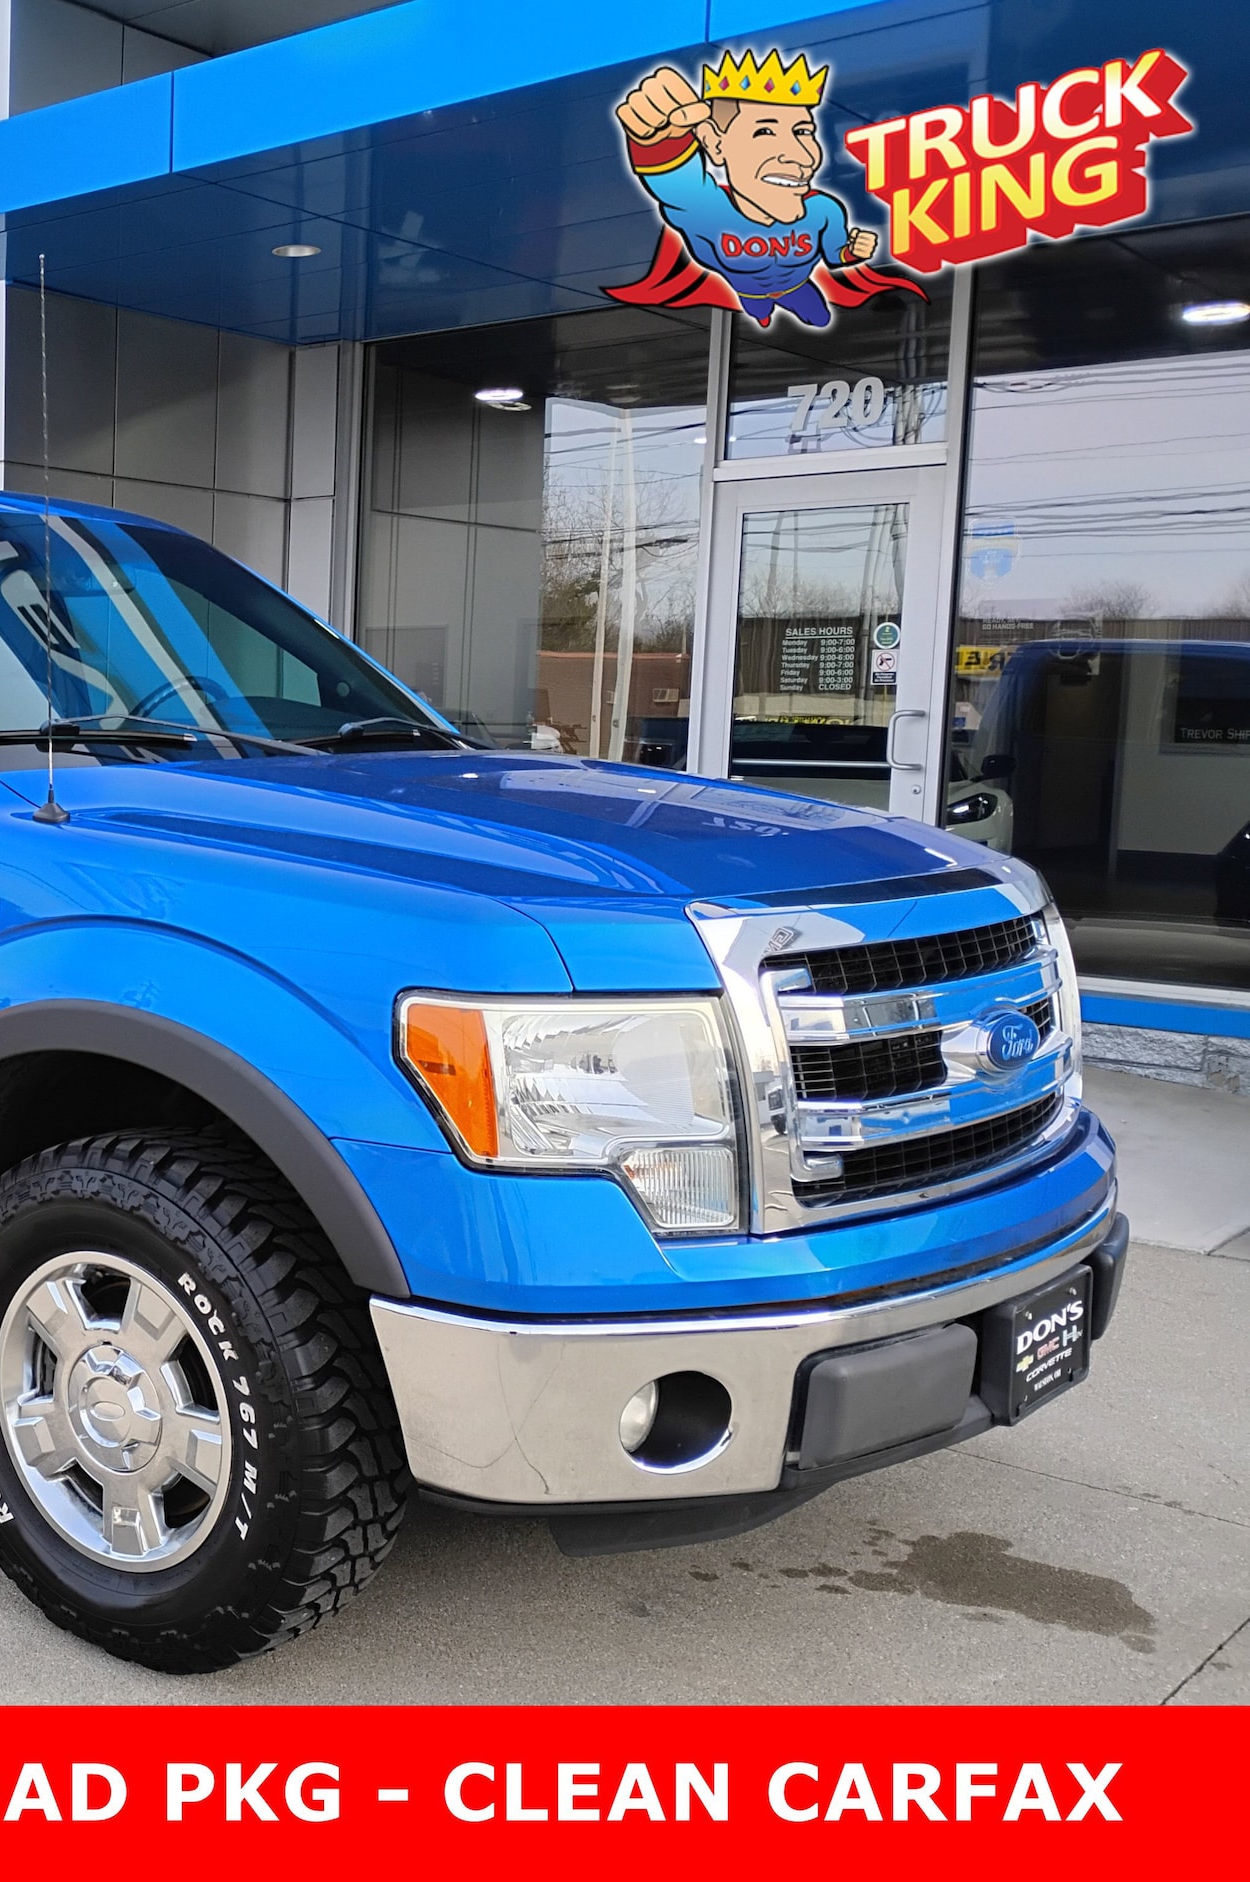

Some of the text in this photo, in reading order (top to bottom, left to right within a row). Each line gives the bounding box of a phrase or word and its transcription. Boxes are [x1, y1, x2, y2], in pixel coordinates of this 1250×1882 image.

[787, 377, 884, 432] 720
[785, 626, 853, 636] SALES HOURS
[821, 638, 855, 646] 9:00-7:00
[1180, 727, 1223, 740] TREVOR
[1002, 1023, 1034, 1061] Ford
[1016, 1300, 1084, 1355] DON'S
[1026, 1348, 1073, 1382] CORVETTE
[177, 1271, 259, 1541] ROCK 767 M/T
